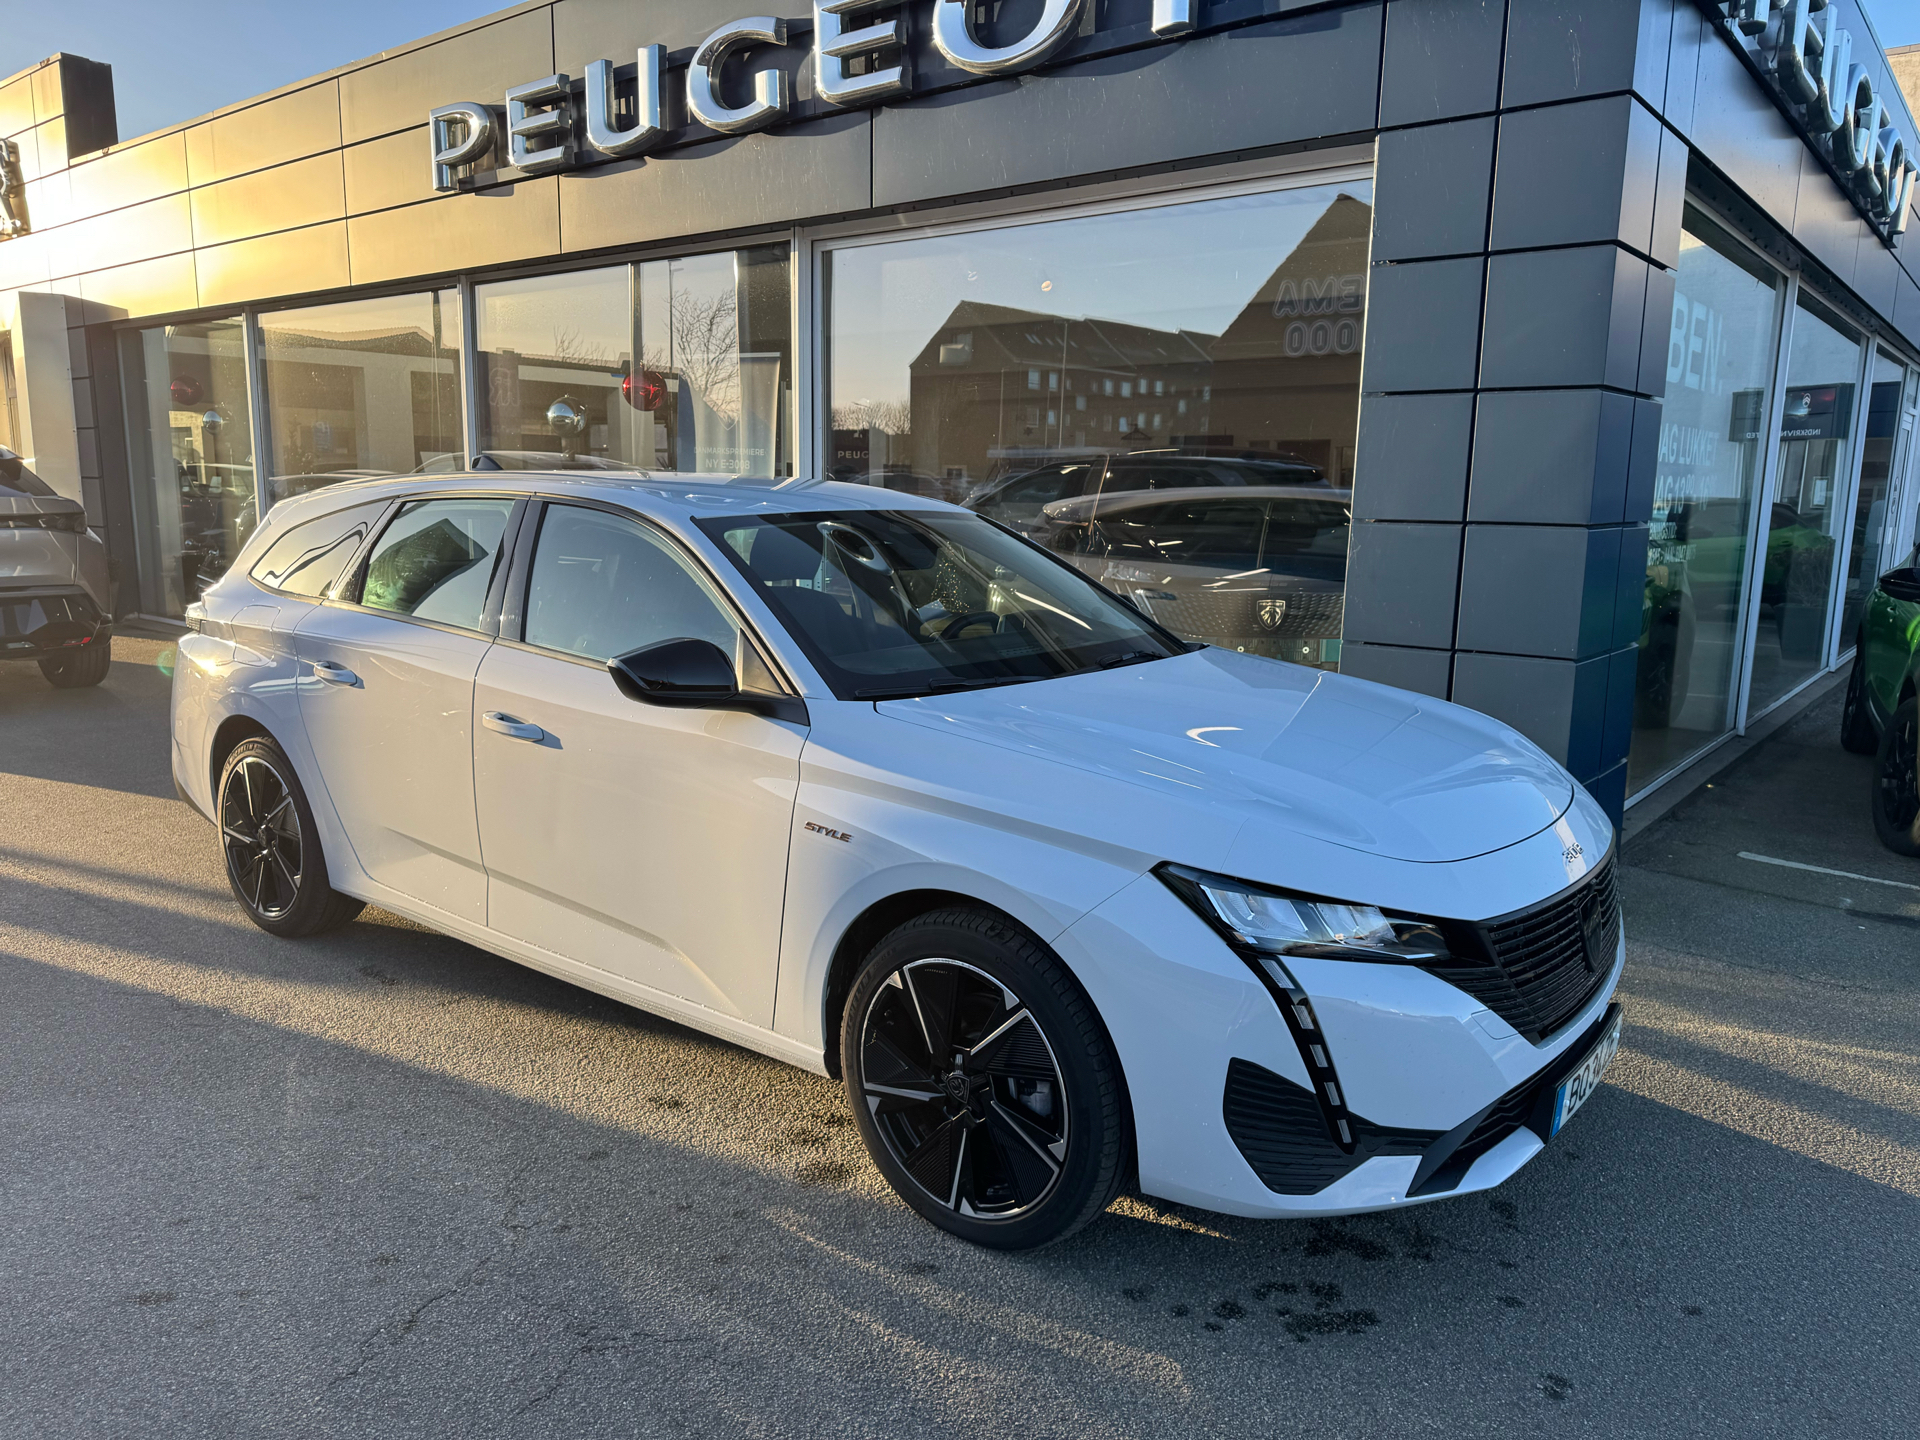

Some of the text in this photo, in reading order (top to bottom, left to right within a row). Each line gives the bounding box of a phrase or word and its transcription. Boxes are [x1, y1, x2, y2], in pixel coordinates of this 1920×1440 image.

[1658, 423, 1720, 466] AG LUKKET
[705, 458, 719, 469] NY
[804, 820, 854, 843] STYLE
[1562, 842, 1584, 863] 308
